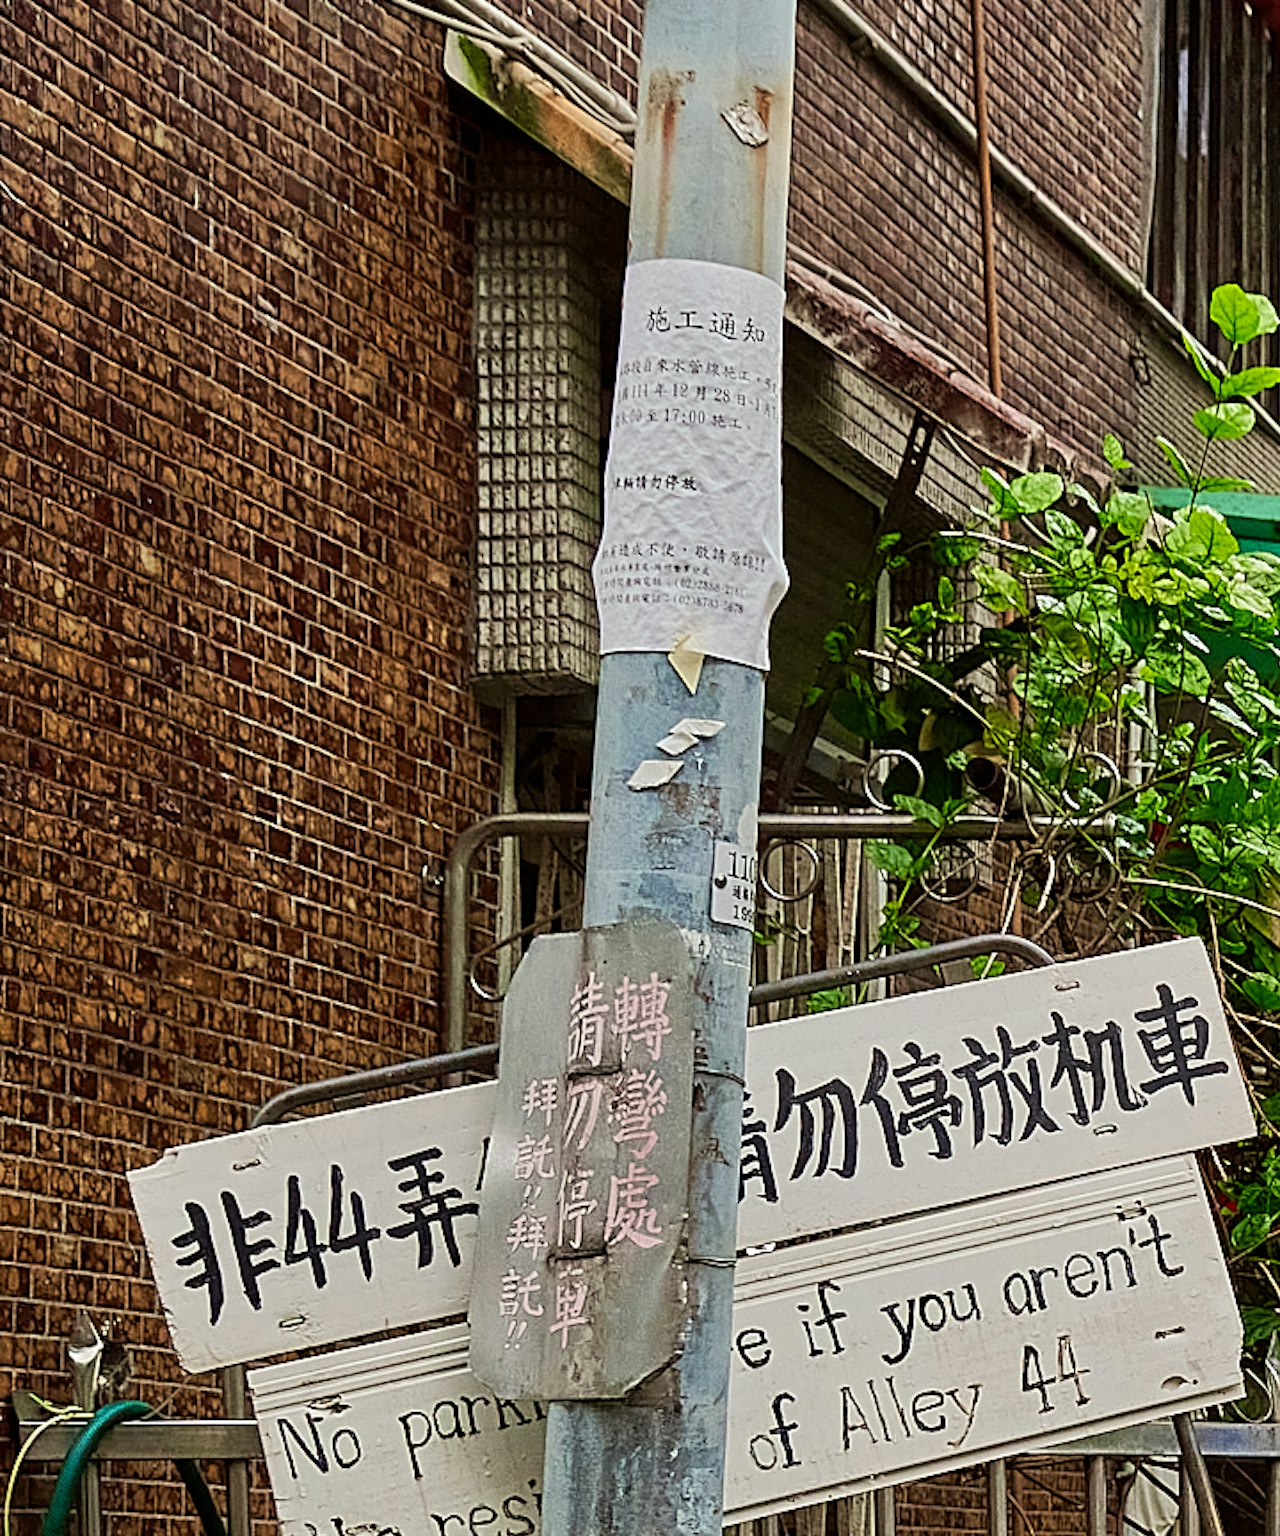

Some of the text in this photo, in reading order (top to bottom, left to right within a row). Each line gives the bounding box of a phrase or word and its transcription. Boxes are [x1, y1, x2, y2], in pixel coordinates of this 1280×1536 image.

[646, 306, 765, 343] 施工通知
[549, 970, 610, 1350] 請勿停車
[602, 971, 673, 1249] 轉彎處
[170, 1135, 491, 1326] 非44弄
[276, 1211, 1185, 1480] No parki e if you aren't
[749, 1393, 802, 1470] of
[840, 1375, 983, 1451] Alley
[1021, 1333, 1092, 1414] 44
